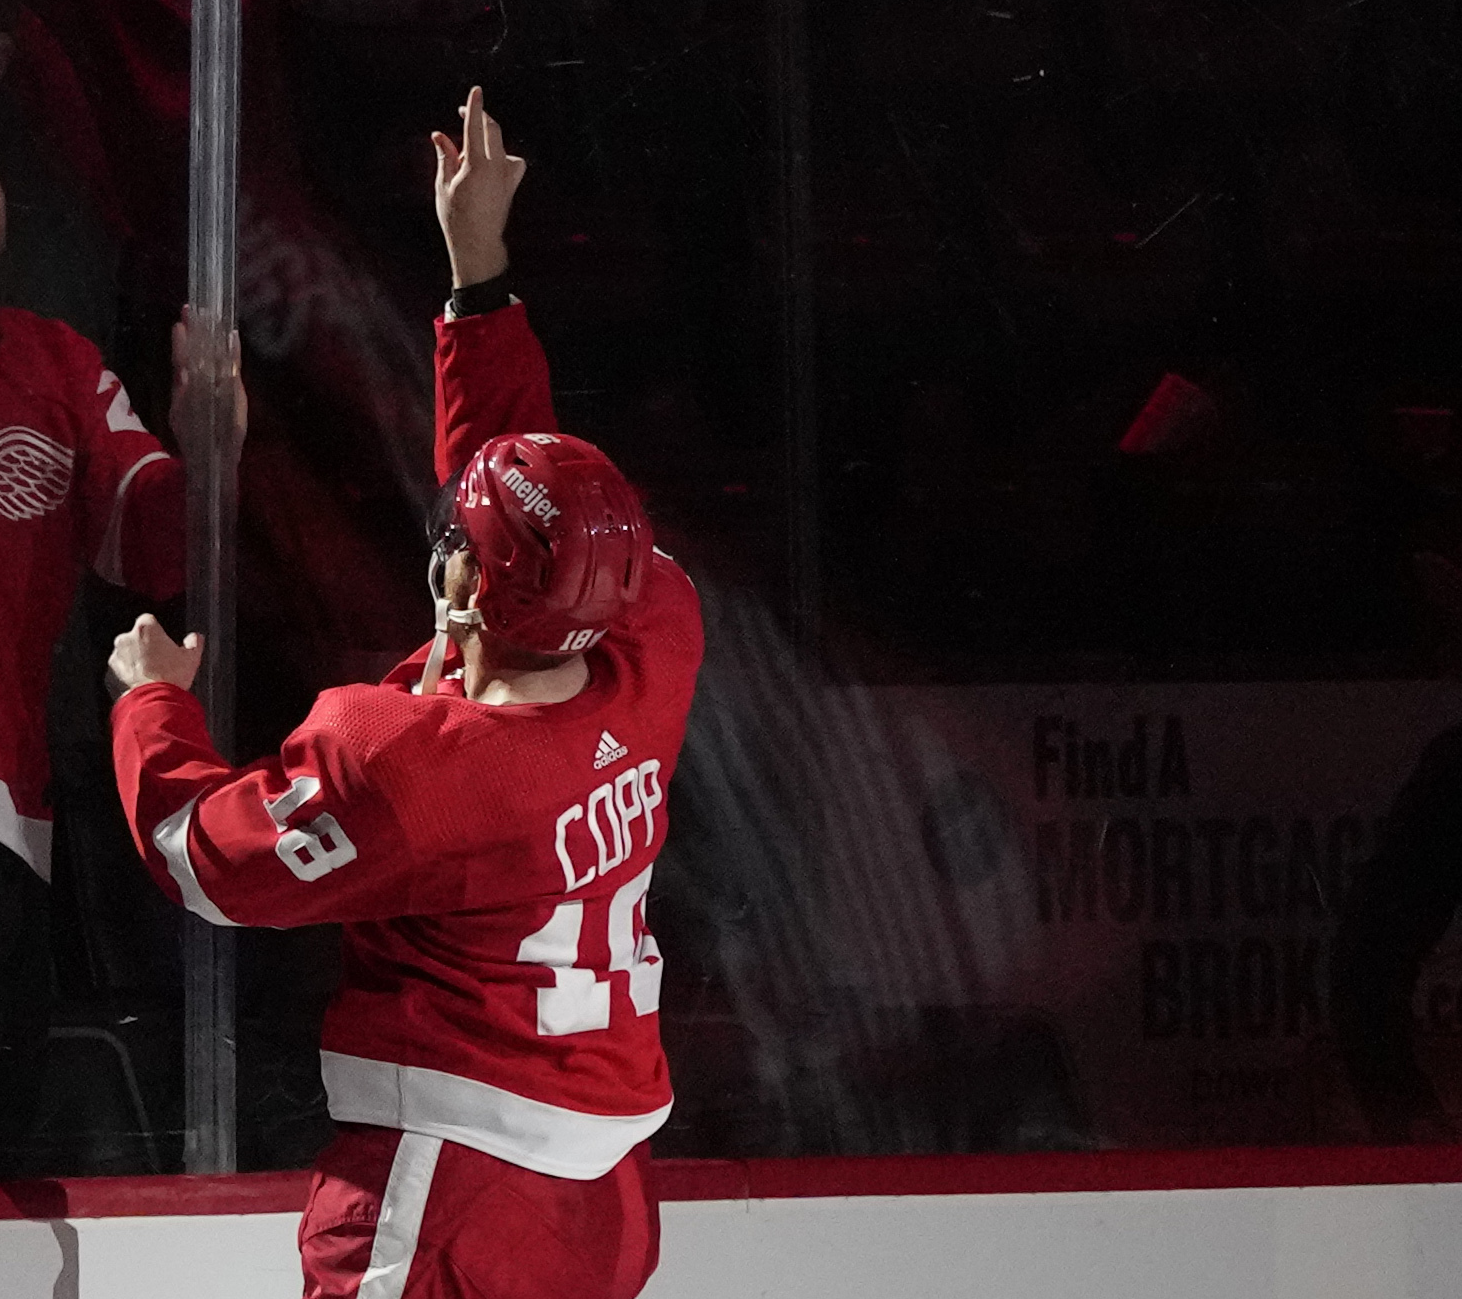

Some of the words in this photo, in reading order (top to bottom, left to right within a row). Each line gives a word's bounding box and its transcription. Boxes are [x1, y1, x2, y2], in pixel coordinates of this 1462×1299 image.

[502, 467, 561, 523] meijer
[558, 628, 594, 651] 18
[593, 745, 629, 770] adidas
[1033, 715, 1144, 799] Find
[1159, 715, 1191, 799] A
[263, 776, 358, 882] 18
[555, 758, 664, 894] COPP
[1036, 815, 1381, 925] MORTGA
[1141, 938, 1322, 1041] BROK
